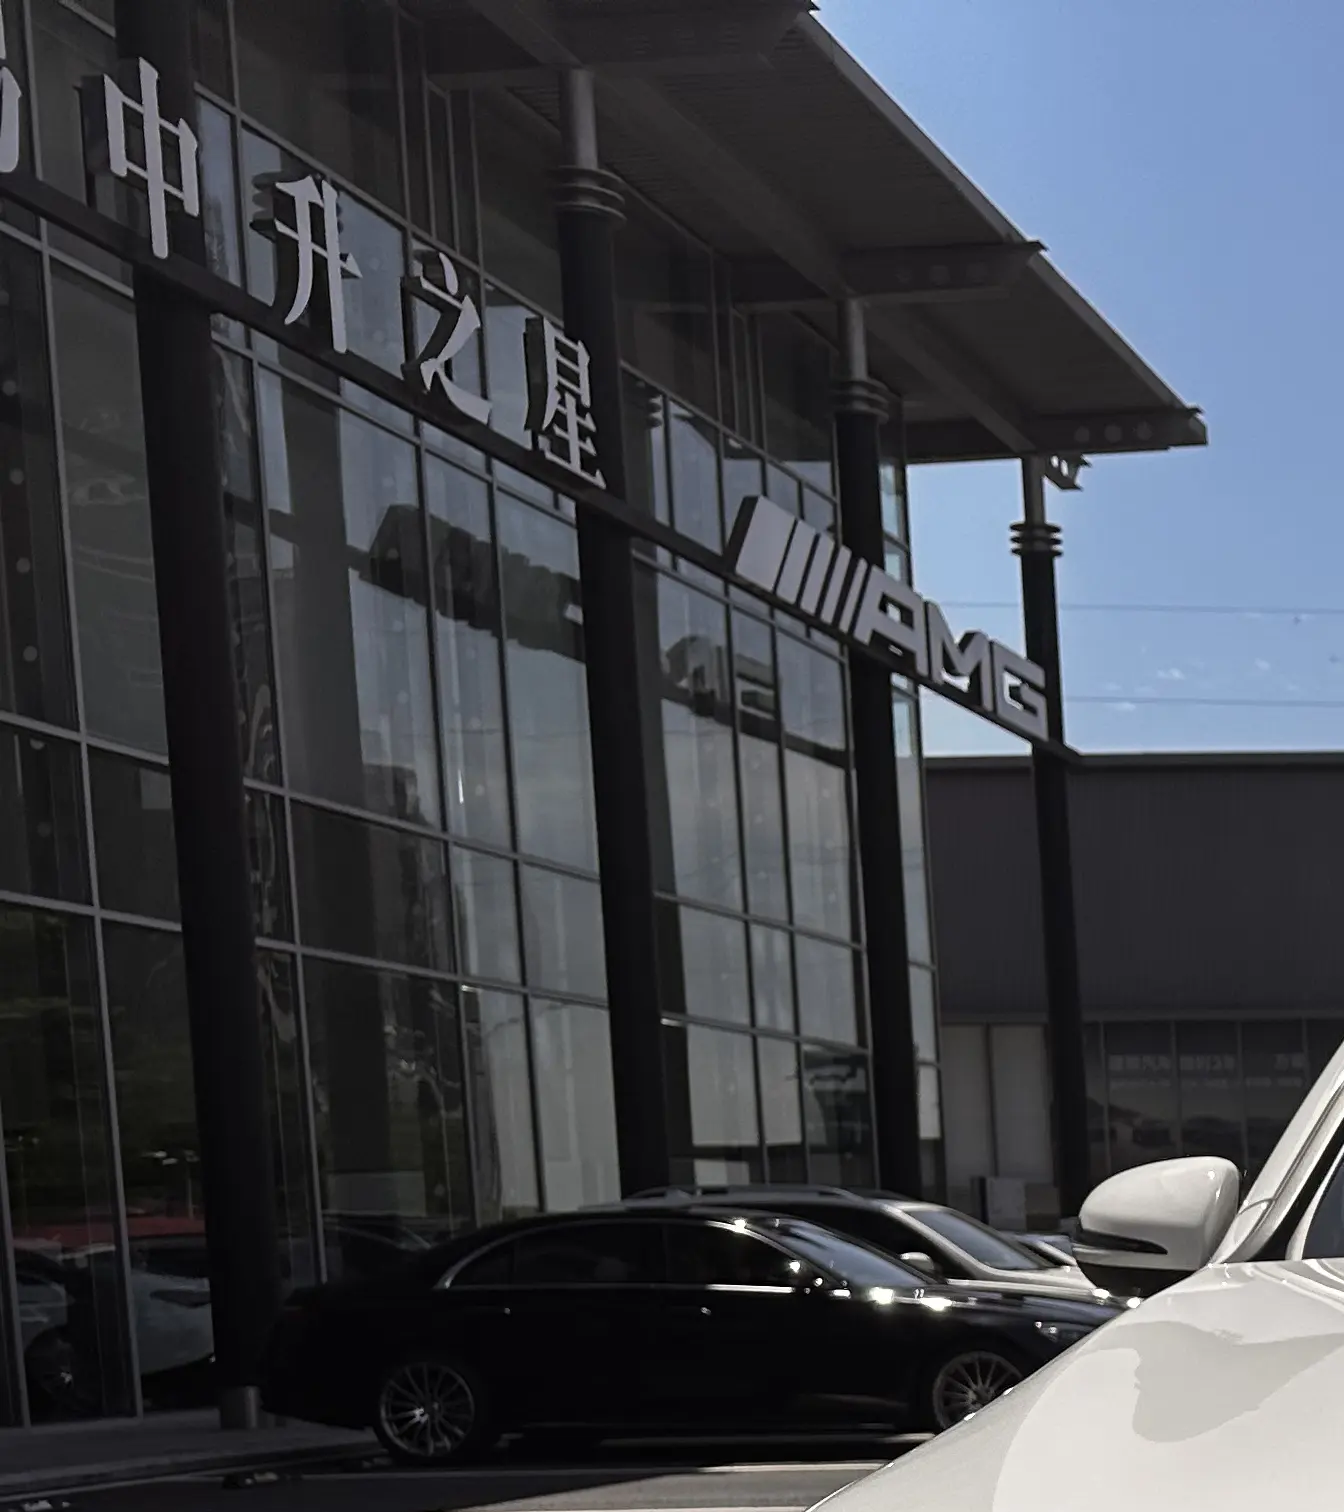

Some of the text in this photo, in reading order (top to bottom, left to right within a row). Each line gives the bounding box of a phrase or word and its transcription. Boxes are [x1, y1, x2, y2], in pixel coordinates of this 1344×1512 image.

[0, 0, 606, 489] 中升之星
[851, 563, 1048, 741] AMG
